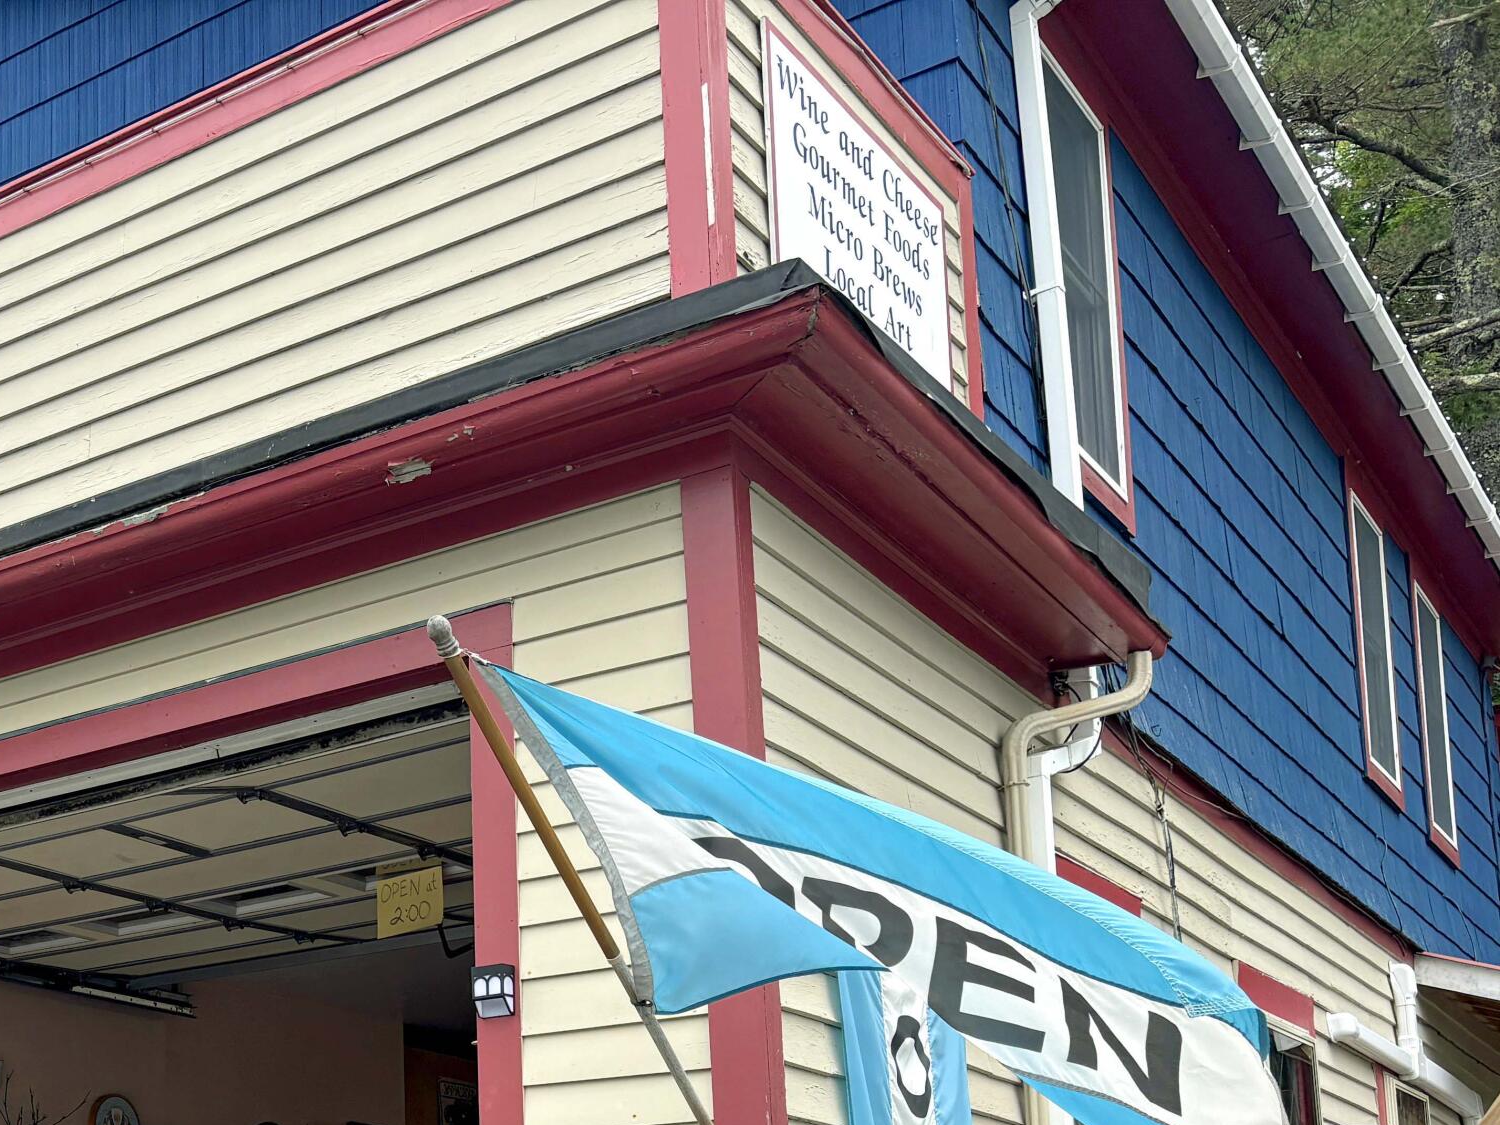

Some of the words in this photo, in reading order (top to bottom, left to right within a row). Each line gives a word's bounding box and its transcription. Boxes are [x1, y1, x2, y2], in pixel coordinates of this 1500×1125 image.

[776, 54, 830, 135] Wine
[838, 129, 875, 182] and
[882, 168, 940, 247] Cheese
[792, 121, 876, 227] Gourmet
[883, 209, 931, 281] Foods
[806, 182, 864, 262] Micro
[871, 244, 923, 317] Brews
[823, 245, 876, 318] Local
[884, 306, 913, 353] Art
[380, 878, 420, 903] OPEN
[426, 872, 438, 893] at
[389, 900, 431, 926] 2:00
